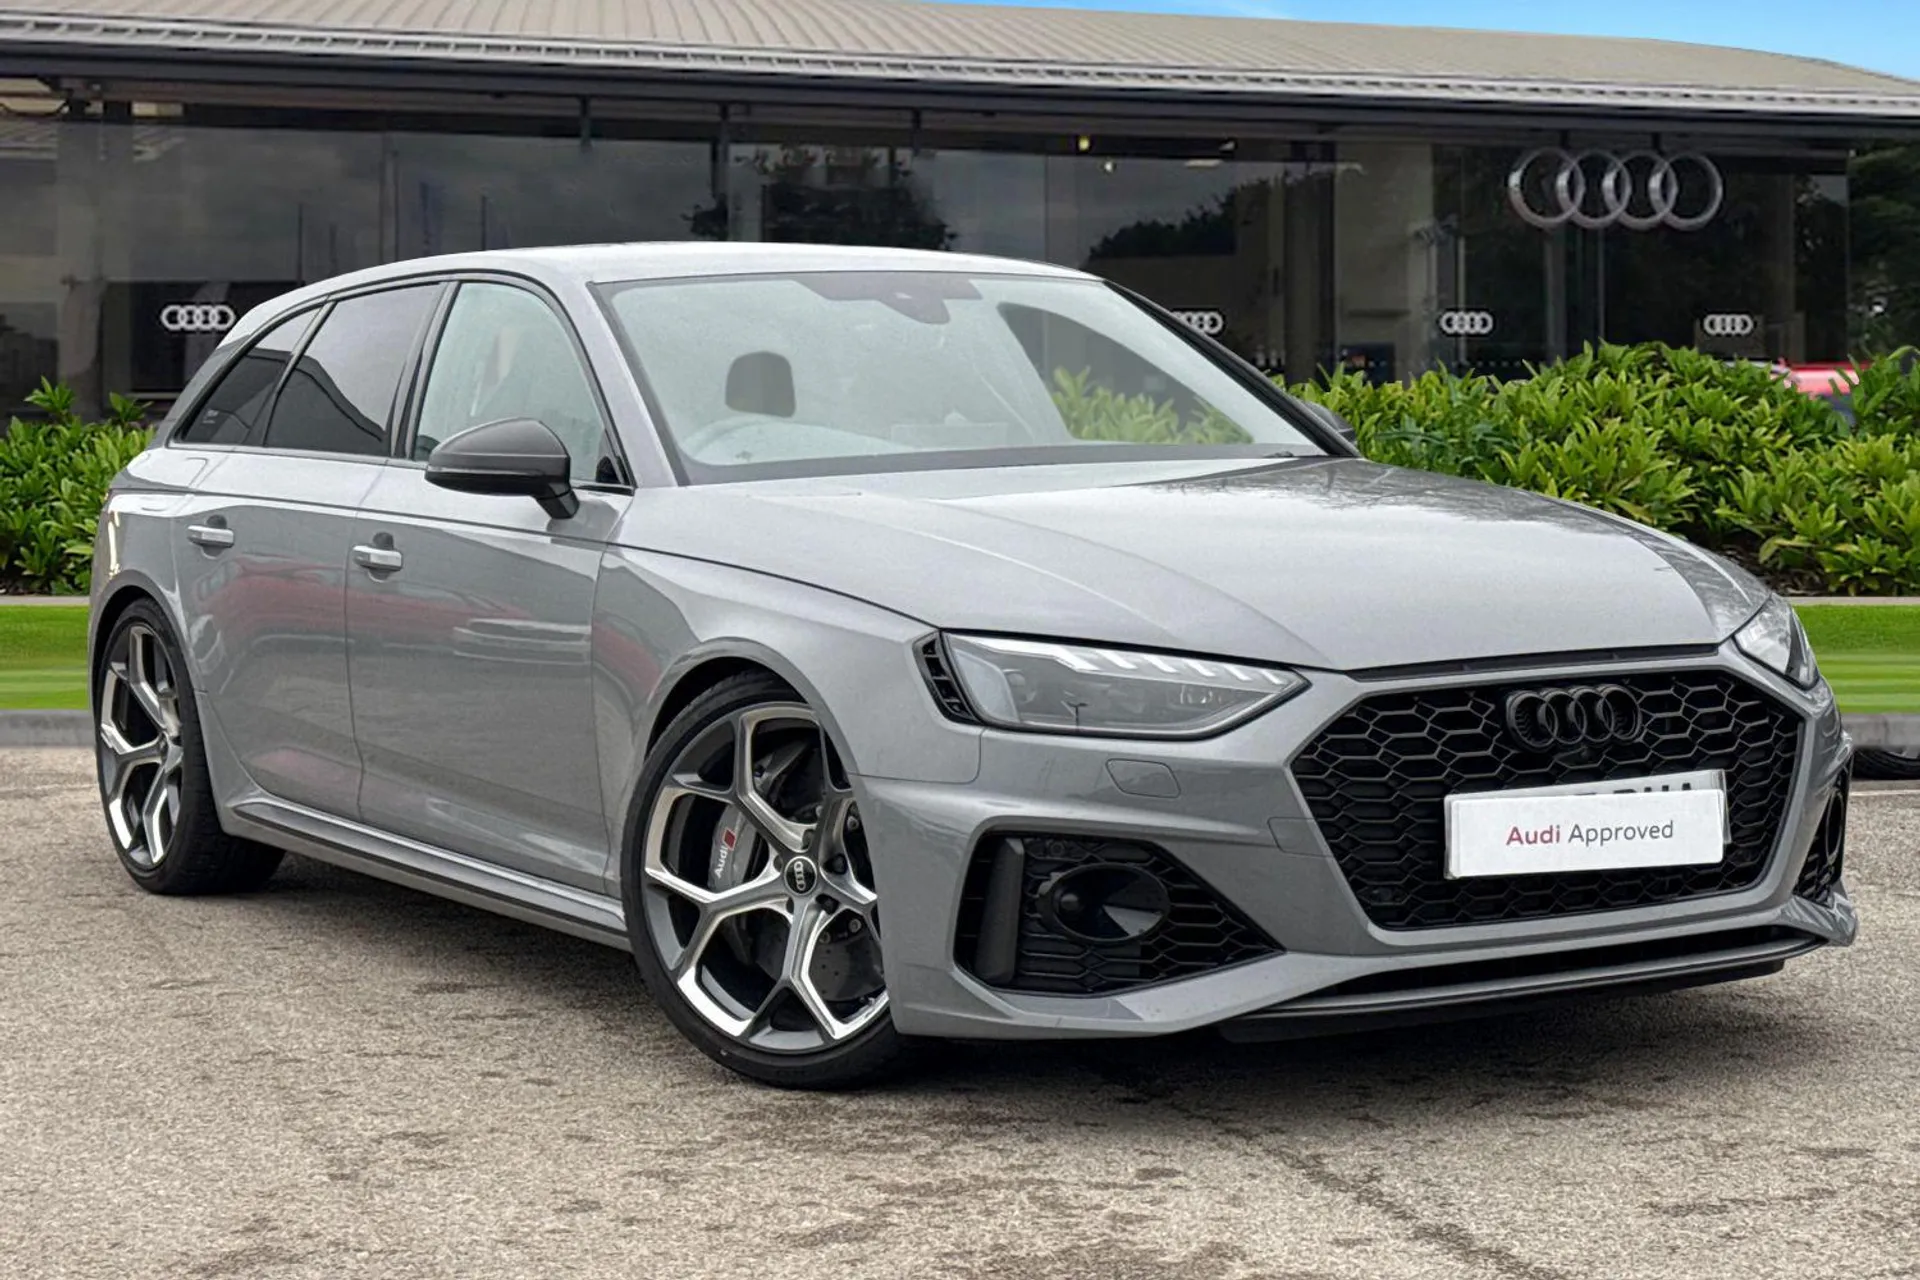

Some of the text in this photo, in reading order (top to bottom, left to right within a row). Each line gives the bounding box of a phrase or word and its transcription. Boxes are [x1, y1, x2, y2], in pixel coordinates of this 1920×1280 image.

[1506, 820, 1673, 846] Audi Approved
[714, 845, 728, 878] Audi
